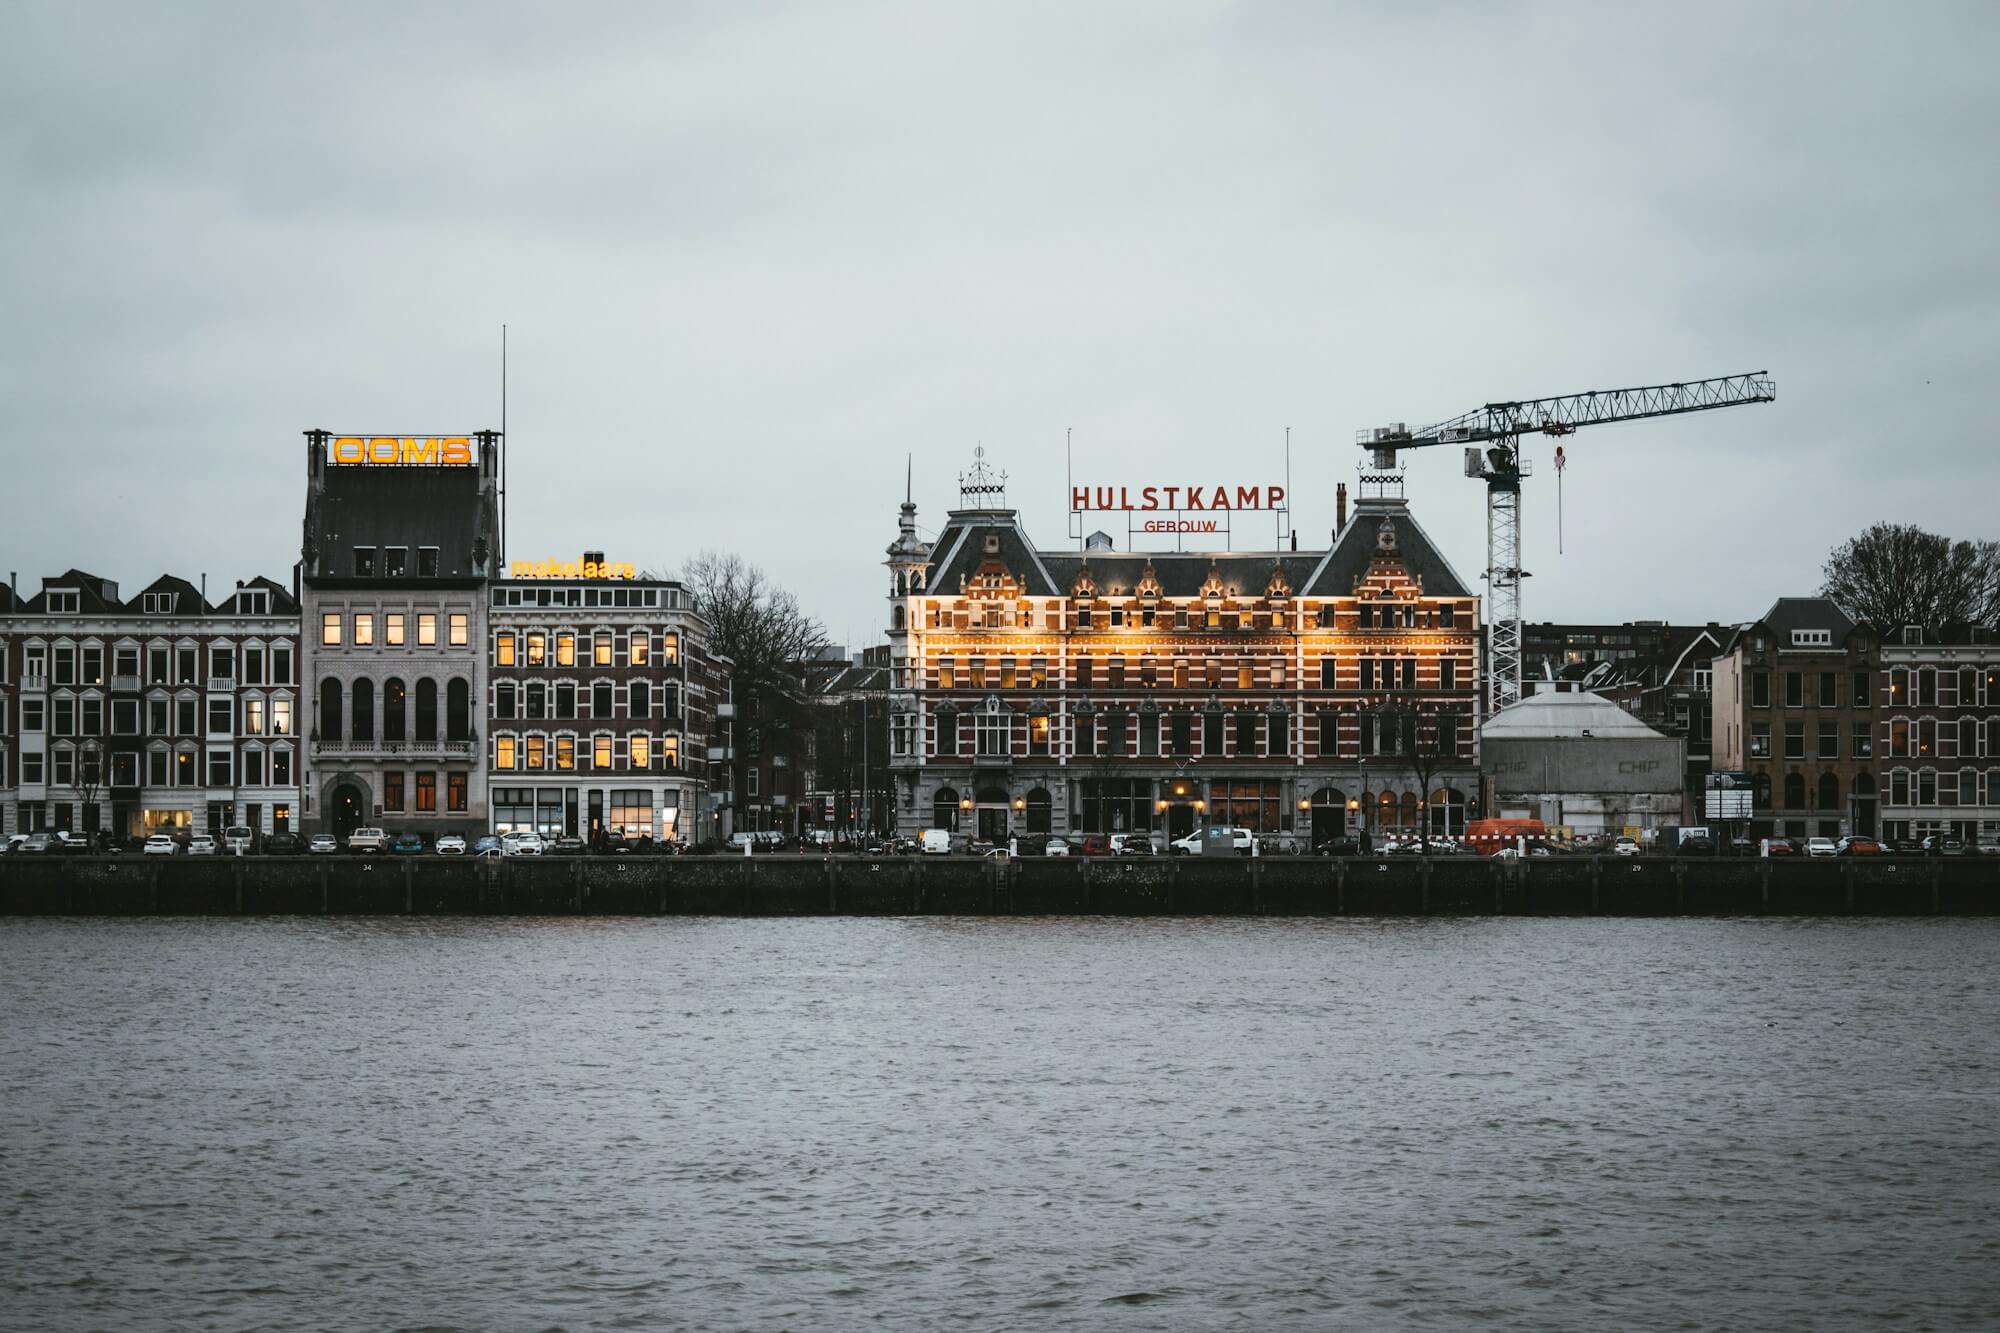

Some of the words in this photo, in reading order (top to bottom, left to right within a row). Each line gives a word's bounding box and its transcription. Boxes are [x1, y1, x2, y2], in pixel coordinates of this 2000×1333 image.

[1446, 429, 1459, 440] BIK
[334, 437, 471, 464] OOMS
[1072, 486, 1285, 510] HULSTKAMP
[1144, 520, 1217, 533] GEBOUW
[511, 555, 635, 578] makelaars
[1618, 760, 1660, 774] CHIP
